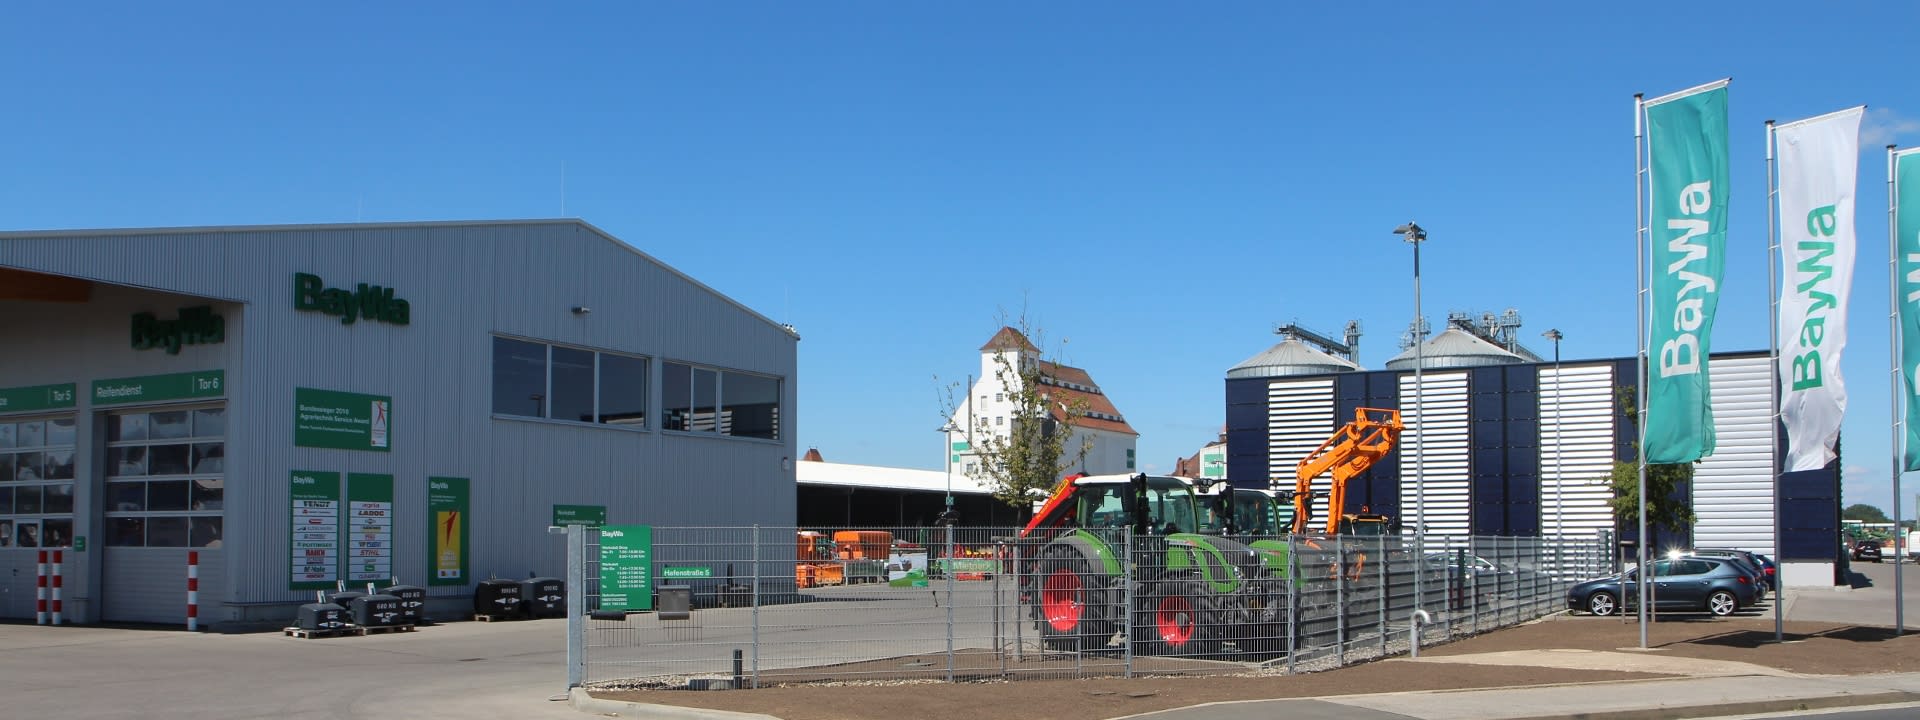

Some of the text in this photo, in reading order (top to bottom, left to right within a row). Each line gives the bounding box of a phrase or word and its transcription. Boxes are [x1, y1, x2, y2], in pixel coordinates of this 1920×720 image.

[1660, 180, 1715, 379] BayWa
[295, 272, 410, 325] BayWa
[1791, 204, 1837, 392] BayWa
[131, 304, 225, 355] BayWa
[54, 391, 64, 401] Tor
[65, 390, 71, 401] 5
[96, 378, 219, 398] Reifendienst Tor 6
[293, 476, 315, 485] BayWa
[601, 530, 624, 538] BayWa
[664, 569, 710, 577] Hafenstraße 5
